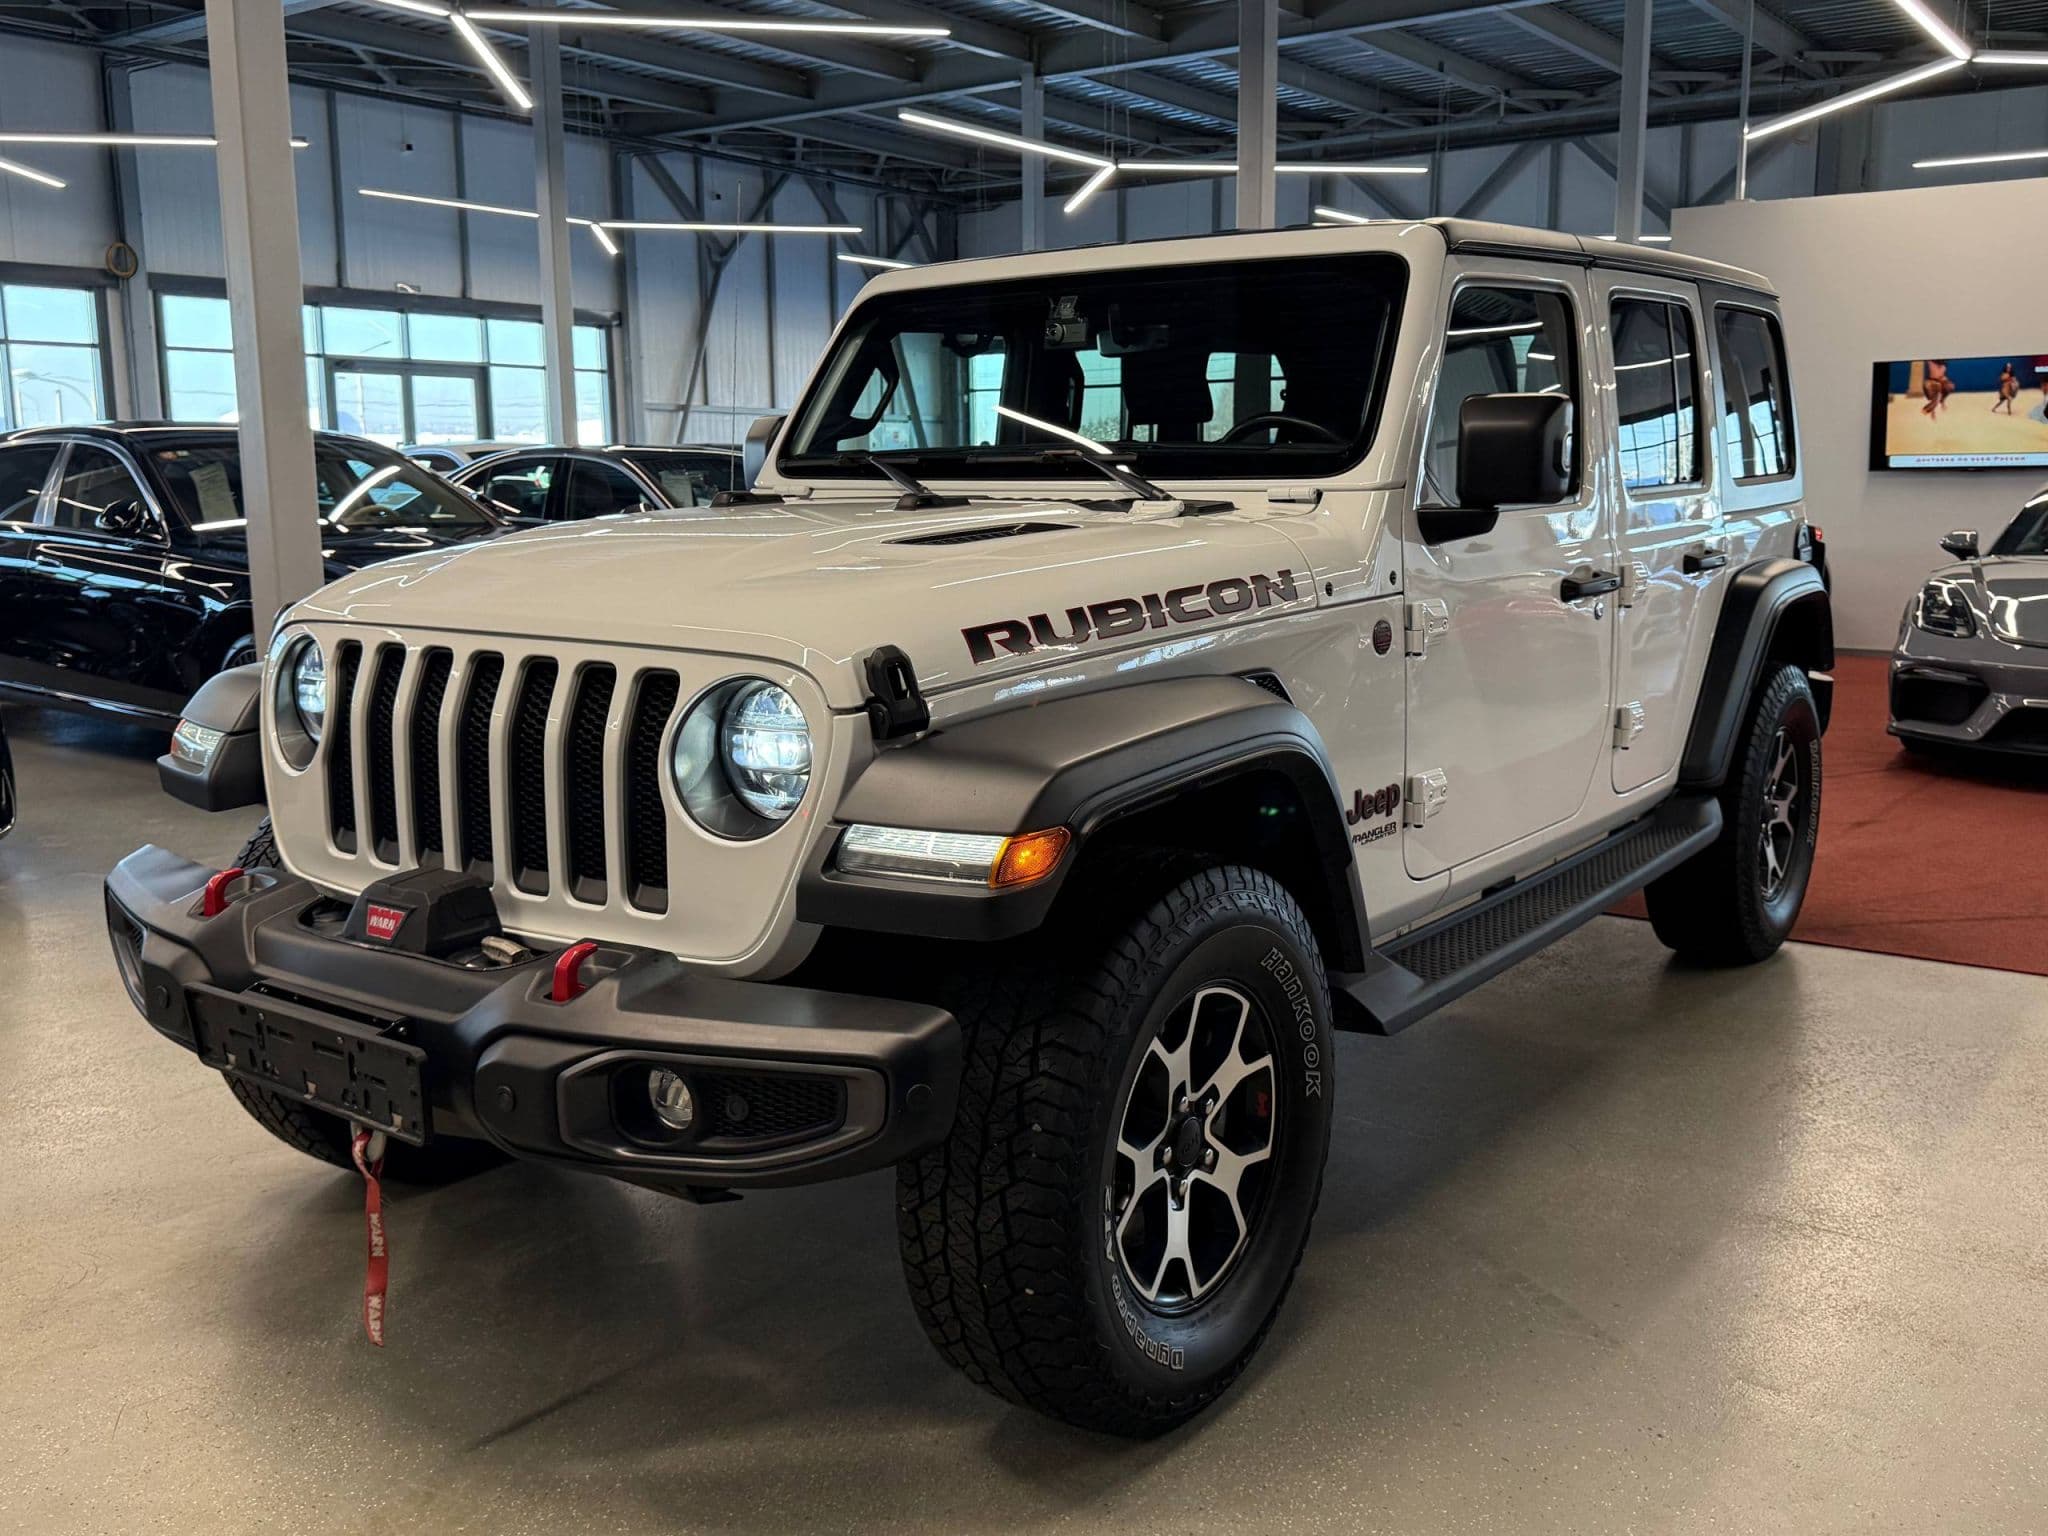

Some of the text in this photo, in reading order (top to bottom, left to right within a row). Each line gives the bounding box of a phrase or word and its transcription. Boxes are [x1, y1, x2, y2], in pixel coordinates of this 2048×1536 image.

[960, 569, 1299, 665] RUBICON
[1345, 783, 1400, 826] Jeep
[369, 915, 396, 931] WARN
[369, 1212, 385, 1257] WARN
